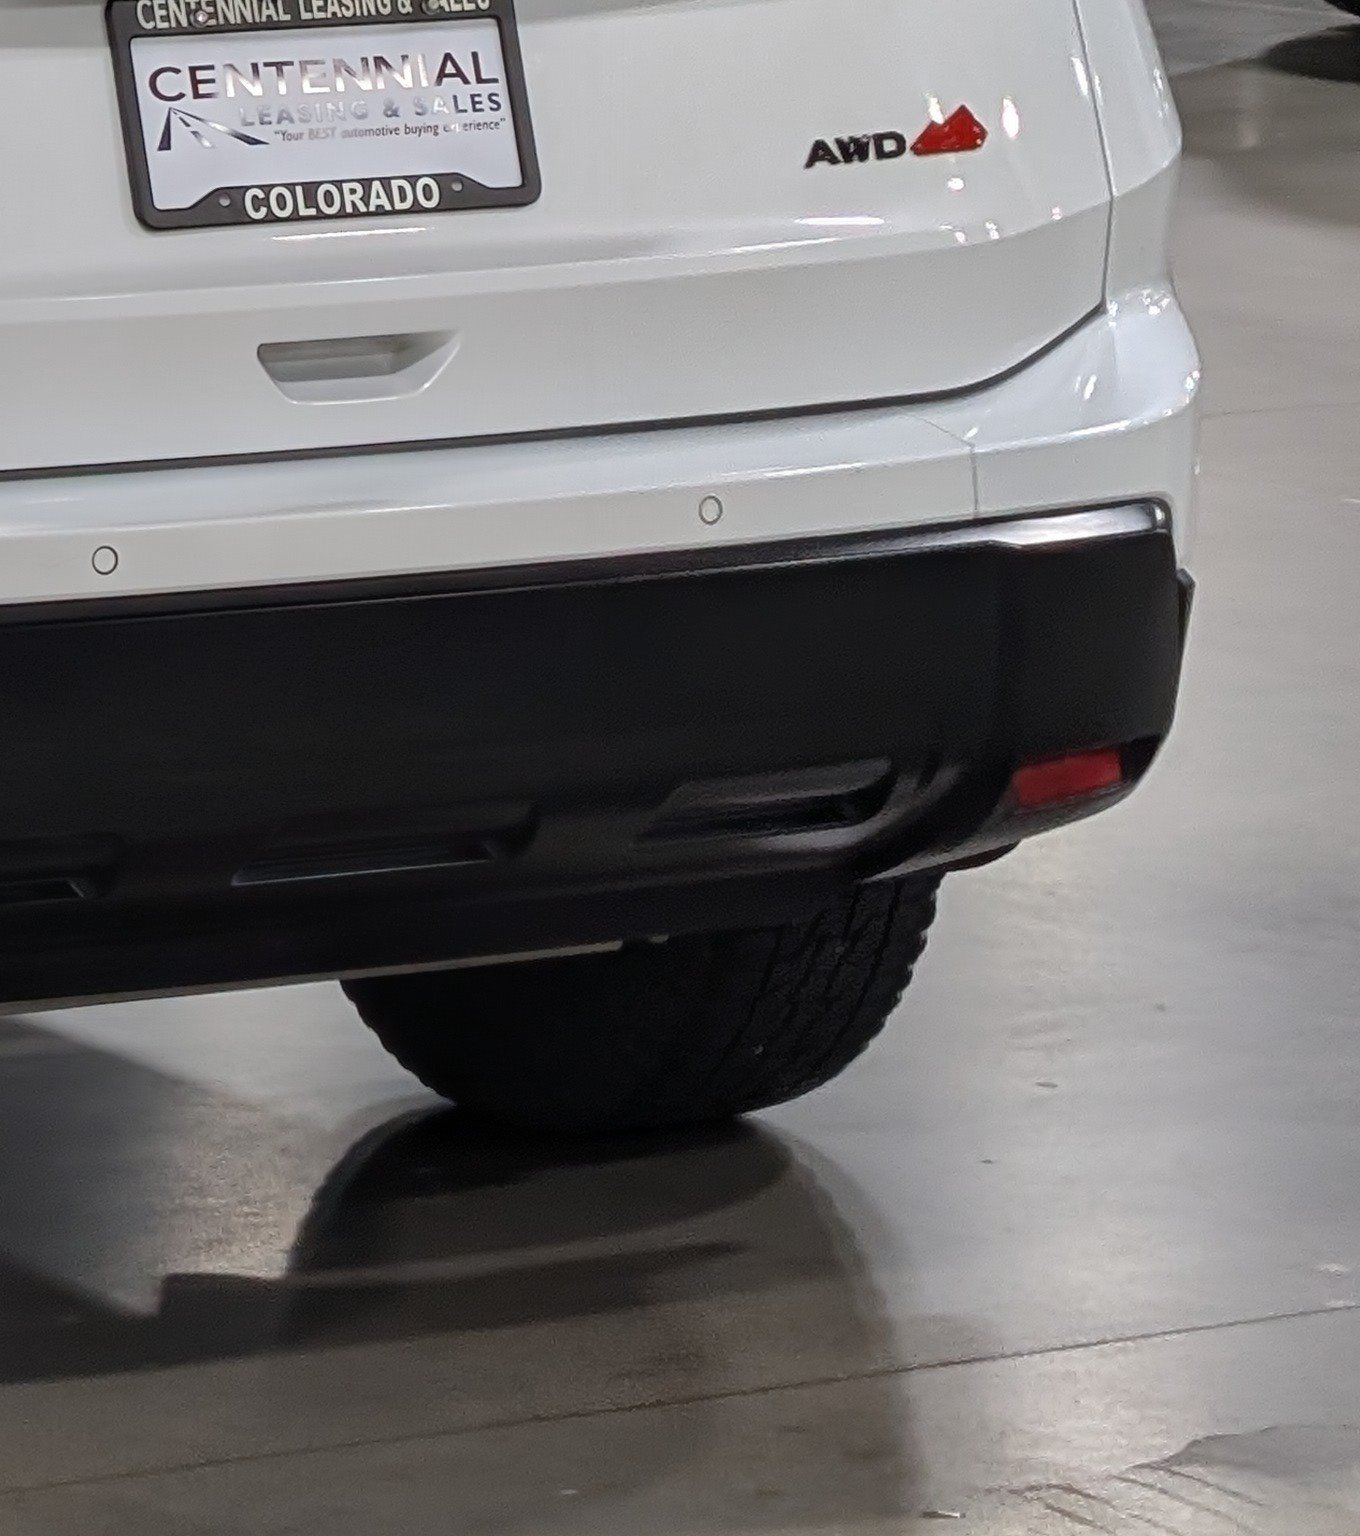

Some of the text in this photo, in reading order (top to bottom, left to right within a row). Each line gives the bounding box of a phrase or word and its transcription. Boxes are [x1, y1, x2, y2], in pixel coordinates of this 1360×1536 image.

[148, 51, 499, 102] CENTENNIAL
[239, 92, 501, 127] LEASING & SALES
[308, 126, 337, 140] BEST
[342, 124, 400, 139] automotive
[404, 123, 439, 138] buying
[804, 130, 907, 169] AWD
[244, 176, 440, 220] COLORADO
